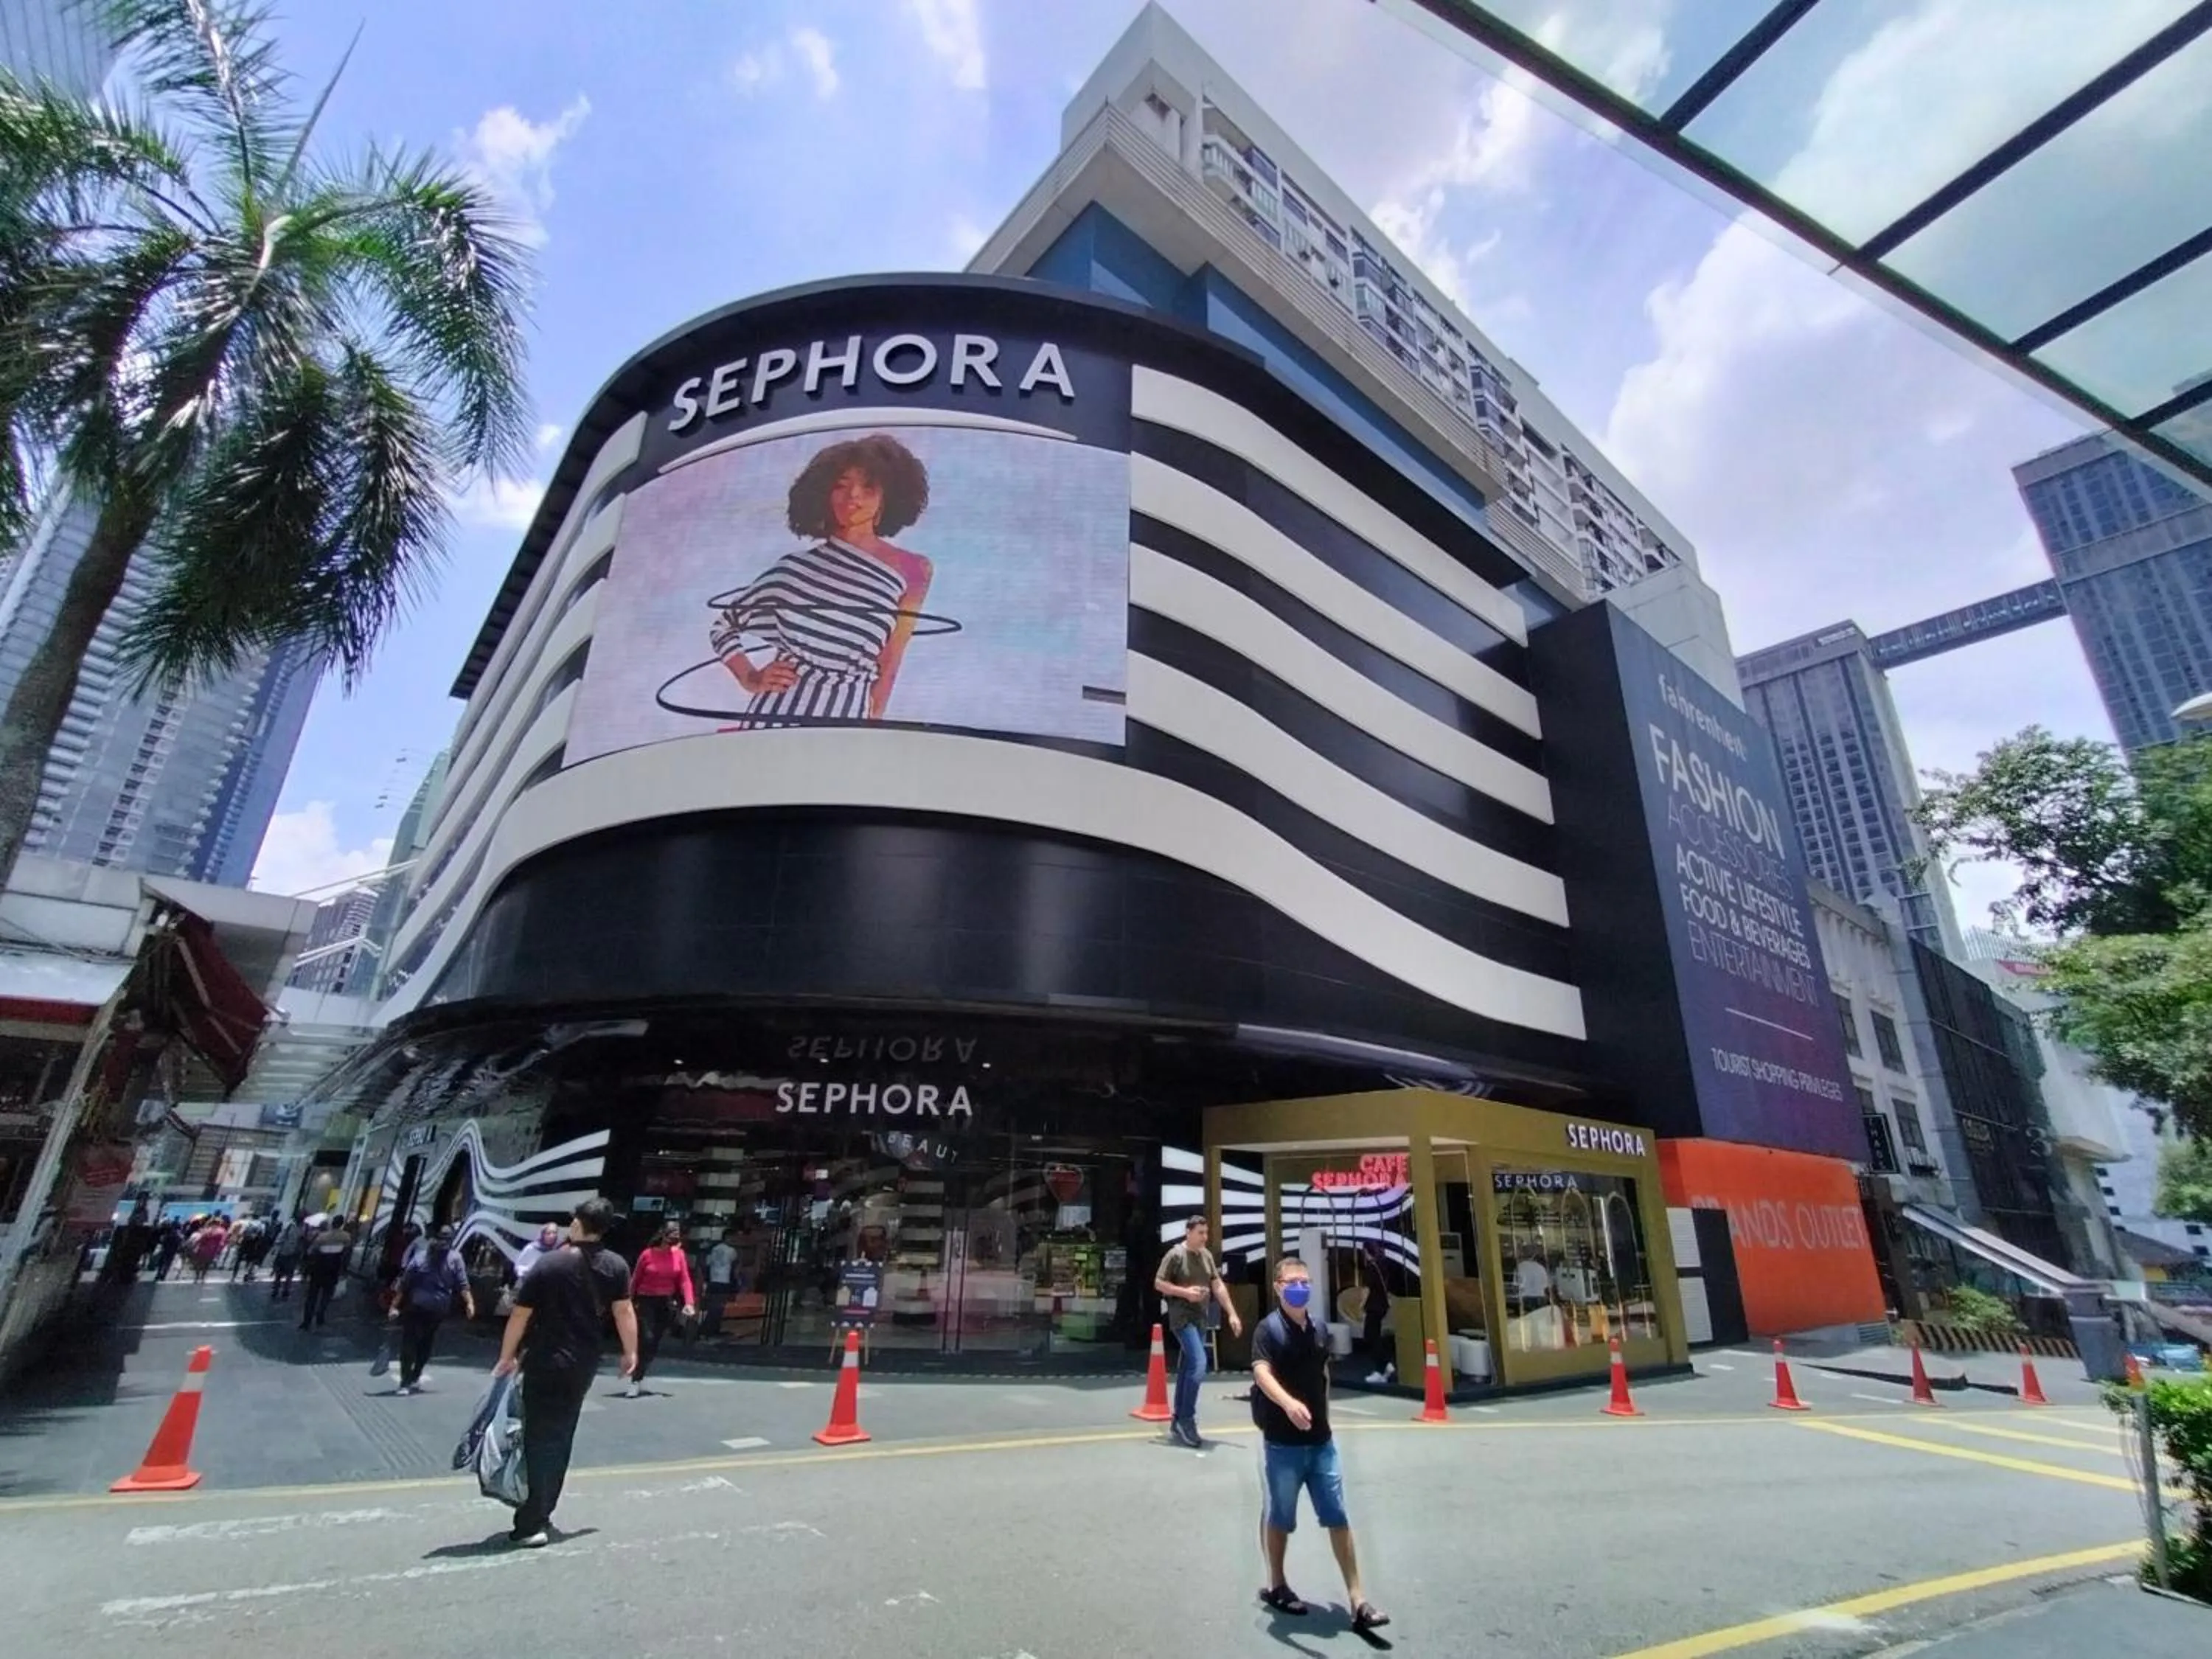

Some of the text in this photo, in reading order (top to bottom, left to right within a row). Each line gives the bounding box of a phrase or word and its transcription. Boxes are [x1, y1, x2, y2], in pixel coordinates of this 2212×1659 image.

[668, 333, 1075, 431] SEPHORA
[1658, 672, 1747, 762] fahrenheit
[1649, 723, 1786, 860] FASHION
[1677, 843, 1804, 939] ACTIVE LIFESTYLE
[1680, 881, 1812, 970] FOOD & BEVERAGES
[1688, 919, 1820, 1008] ENTERTAINMENT
[776, 1082, 973, 1116] SEPHORA
[1711, 1047, 1752, 1079] TOURIST
[1750, 1058, 1800, 1091] SHOPPING
[1568, 1123, 1646, 1157] SEPHORA
[1312, 1171, 1408, 1190] SEPHORA
[1494, 1174, 1579, 1189] SEPHORA
[1795, 1203, 1866, 1250] OUTLET
